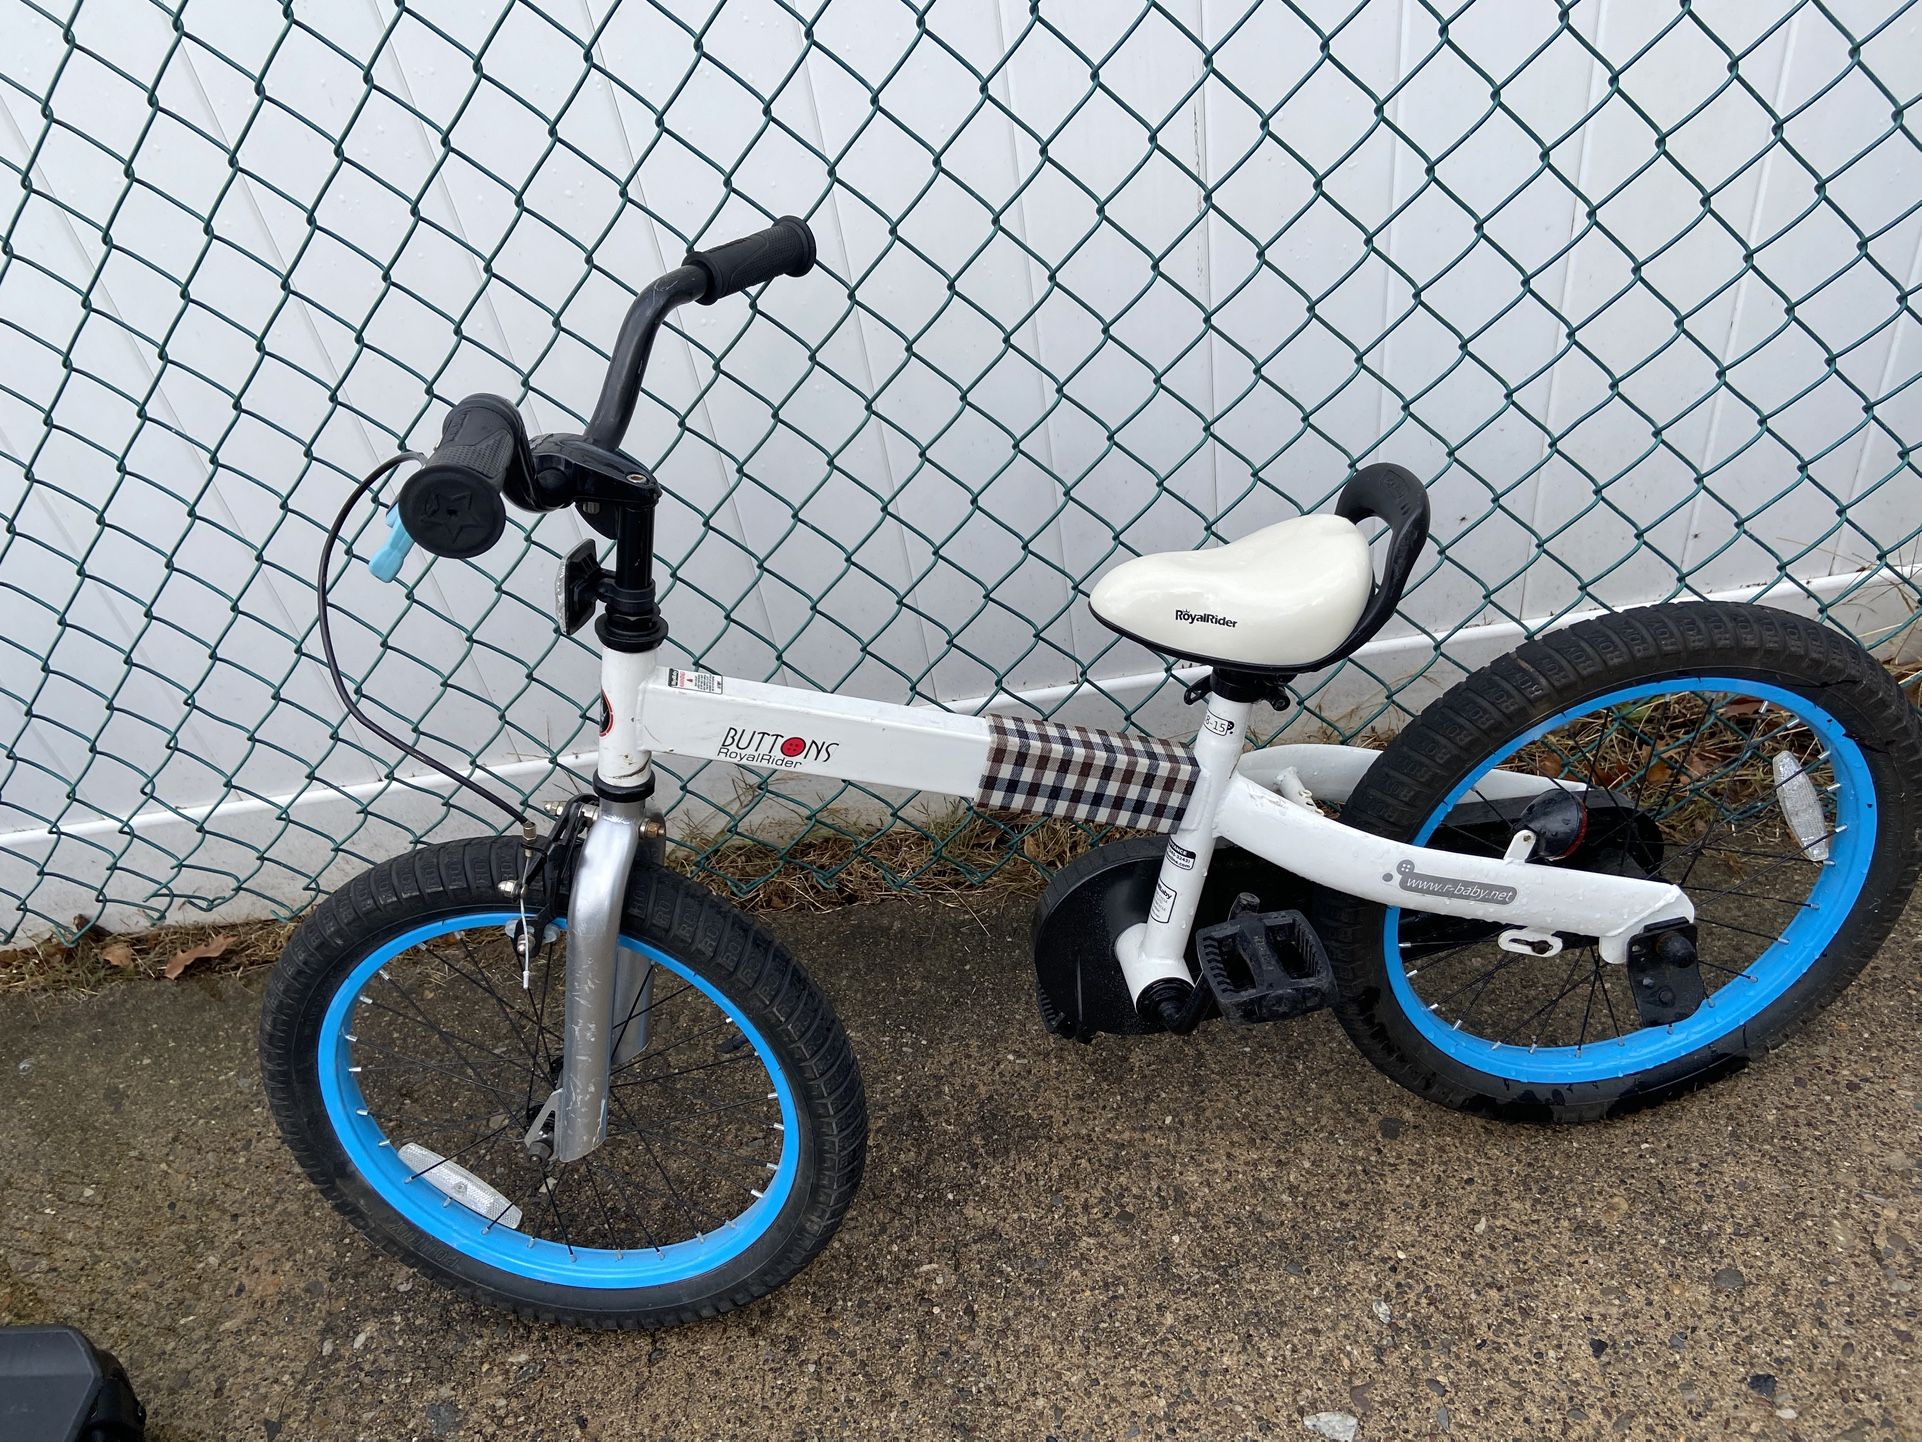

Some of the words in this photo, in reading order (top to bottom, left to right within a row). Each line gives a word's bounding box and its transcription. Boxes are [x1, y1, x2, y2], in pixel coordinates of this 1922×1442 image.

[1175, 609, 1238, 628] RoyalRider
[721, 727, 840, 763] BUTTONS
[717, 747, 802, 769] RoyalRider
[1406, 877, 1514, 902] www.r-baby.net
